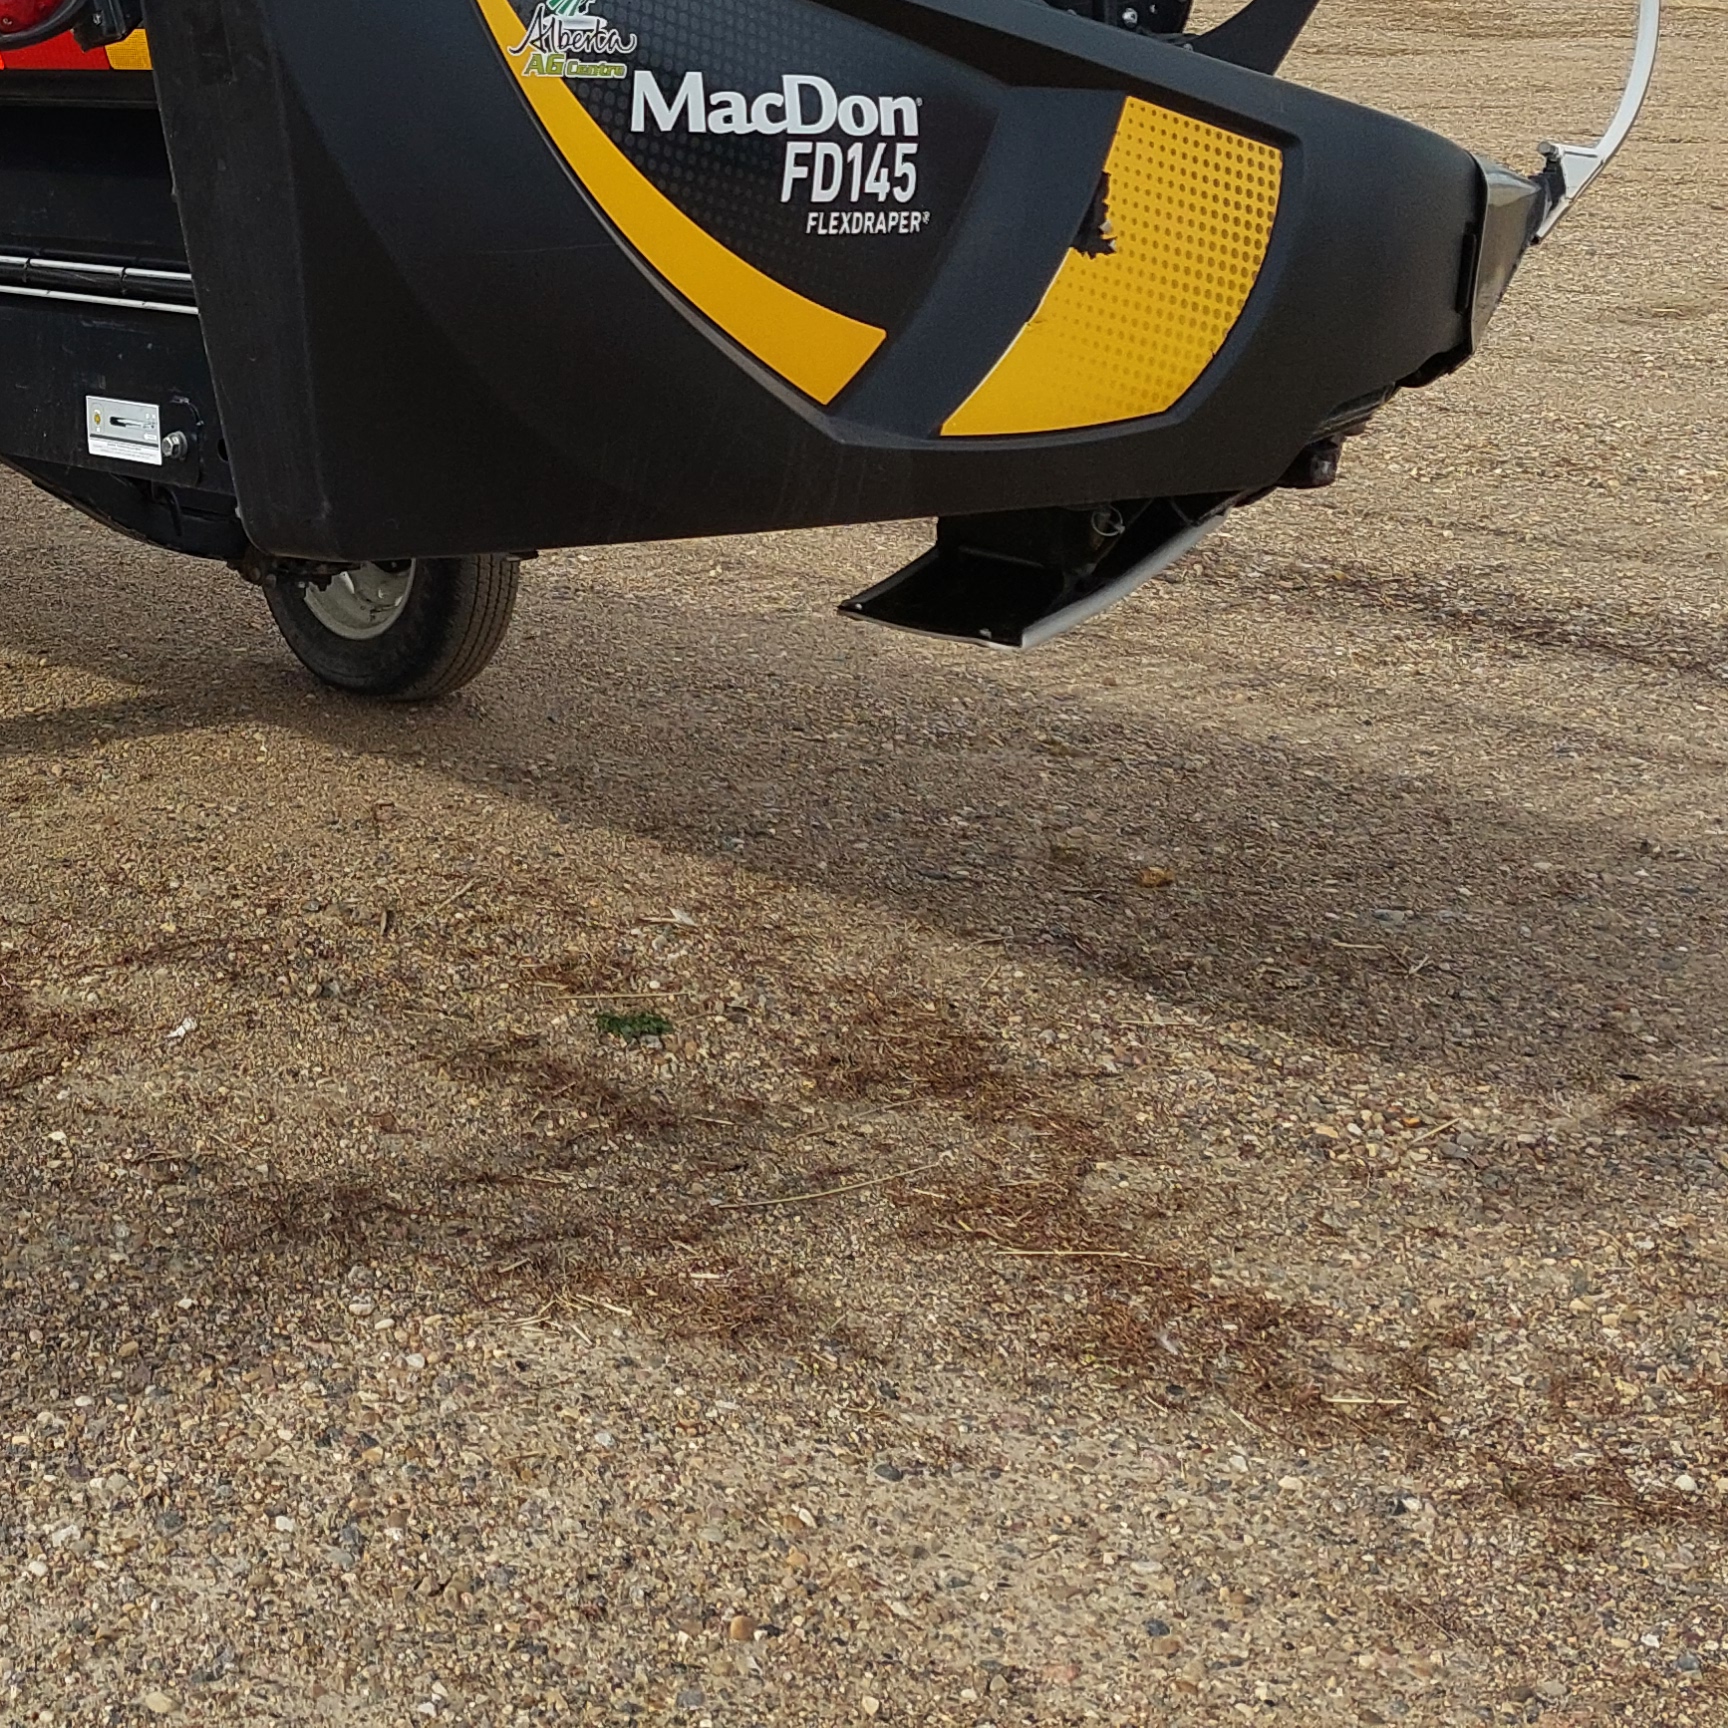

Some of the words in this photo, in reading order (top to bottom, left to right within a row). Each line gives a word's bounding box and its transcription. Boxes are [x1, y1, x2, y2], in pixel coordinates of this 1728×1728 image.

[507, 3, 638, 56] Alberta
[522, 53, 566, 77] AG
[565, 58, 628, 79] Centre
[630, 70, 920, 136] MacDon
[780, 141, 919, 203] FD145
